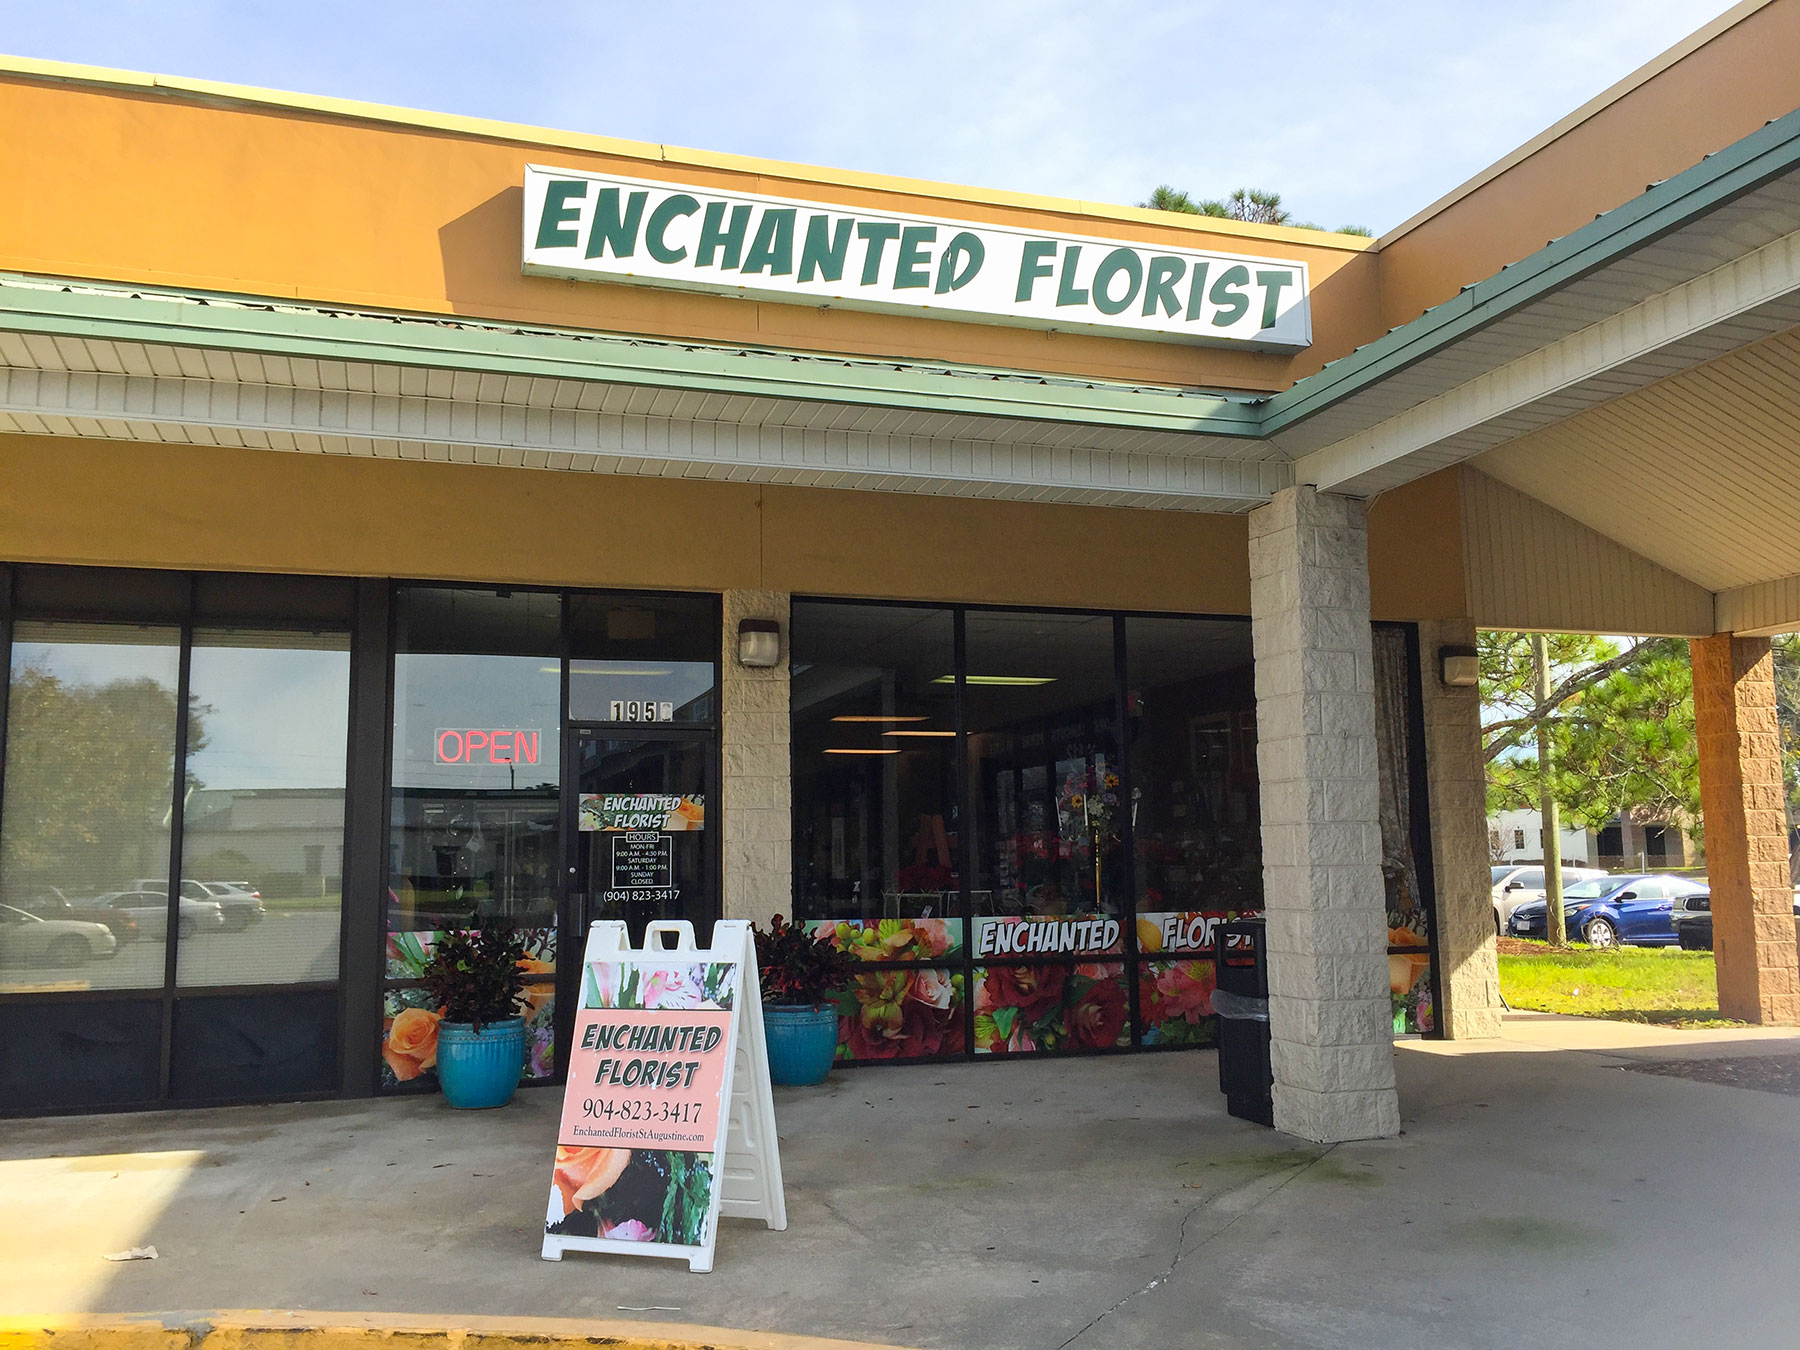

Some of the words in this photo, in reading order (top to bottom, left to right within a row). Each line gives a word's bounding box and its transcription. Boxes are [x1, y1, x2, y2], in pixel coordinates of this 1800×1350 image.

[535, 180, 986, 295] ENCHANTED
[1014, 240, 1293, 330] FLORIST
[438, 730, 538, 763] OPEN
[603, 796, 682, 812] ENCHANTED
[613, 813, 671, 829] FLORIST
[629, 833, 656, 841] HOURS
[603, 891, 630, 902] (904)
[632, 890, 680, 901] 823-3417
[979, 919, 1121, 955] ENCHANTED
[580, 1023, 723, 1053] ENCHANTED
[594, 1058, 701, 1088] FLORIST
[583, 1098, 703, 1124] 904-823-3417
[573, 1125, 705, 1143] EnchantedFloristStAugustine.com
